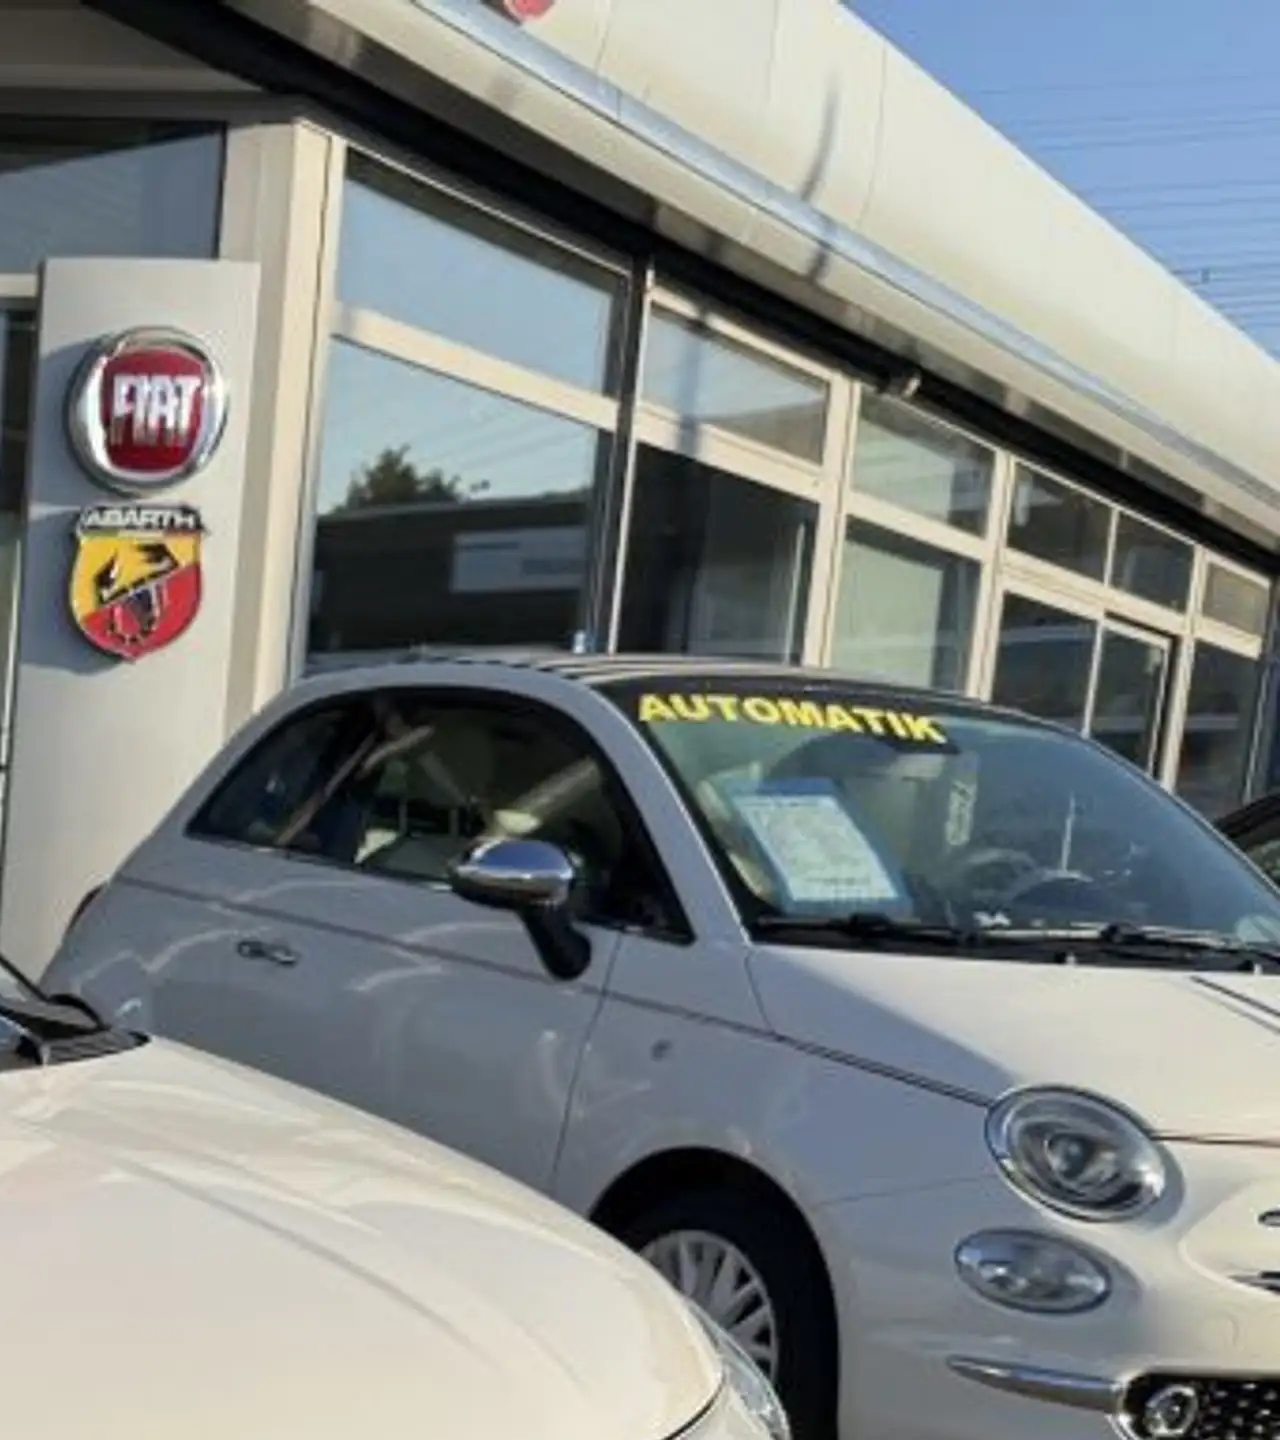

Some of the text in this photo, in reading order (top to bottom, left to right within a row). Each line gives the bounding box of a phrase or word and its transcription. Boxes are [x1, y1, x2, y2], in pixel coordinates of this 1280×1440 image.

[110, 373, 201, 446] FIAT
[85, 507, 196, 529] ABARTH
[638, 693, 948, 744] AUTOMATIK
